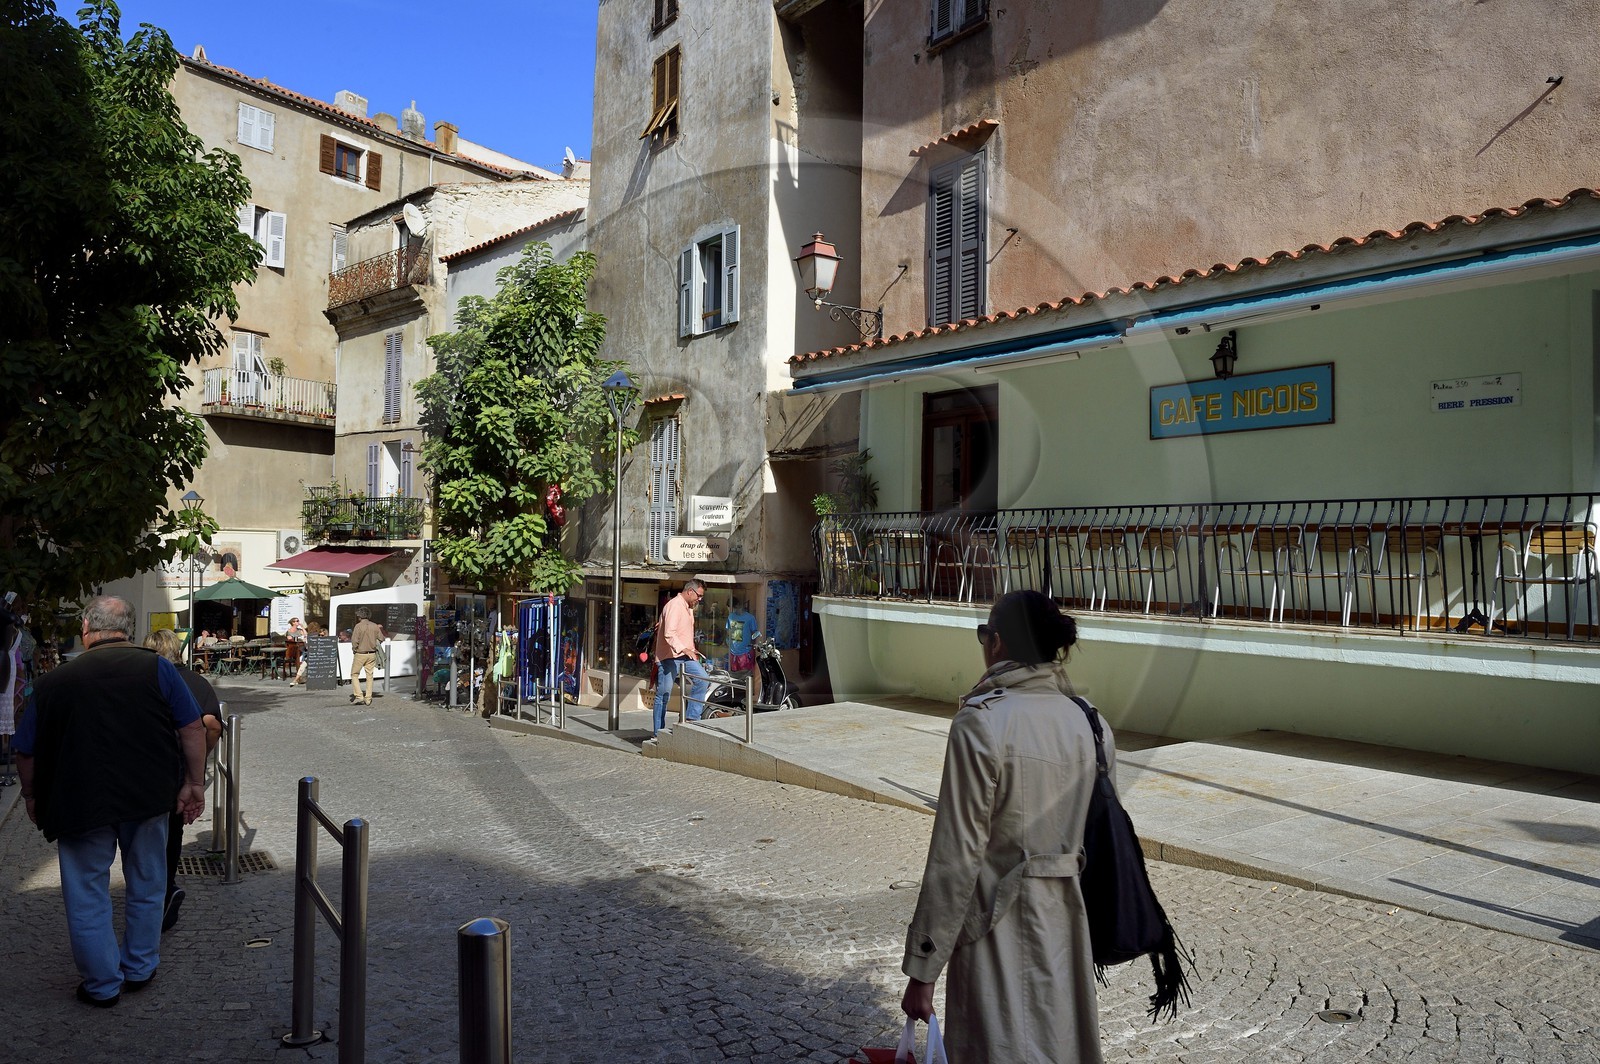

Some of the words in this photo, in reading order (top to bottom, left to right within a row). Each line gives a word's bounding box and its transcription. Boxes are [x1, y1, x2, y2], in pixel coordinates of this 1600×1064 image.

[1159, 393, 1223, 426] CAFE
[1232, 381, 1318, 419] NICOIS
[1438, 400, 1465, 410] BIERE
[1469, 396, 1514, 408] PRESSION
[698, 503, 729, 511] souvenirs
[680, 542, 696, 550] drap
[682, 551, 695, 559] tee
[697, 551, 715, 559] shirt
